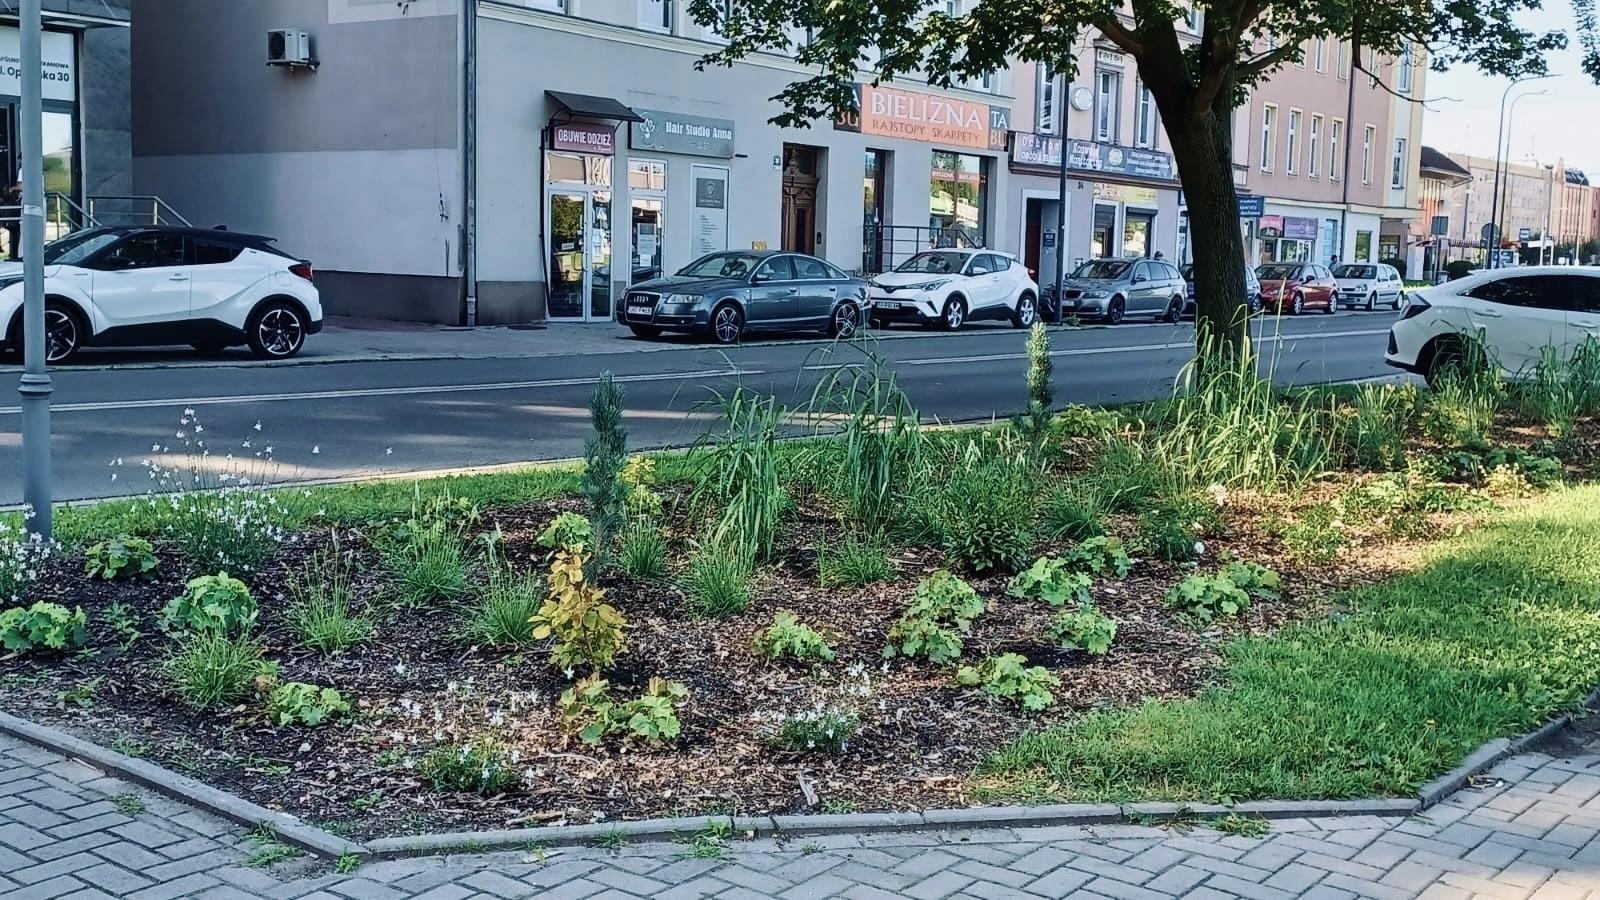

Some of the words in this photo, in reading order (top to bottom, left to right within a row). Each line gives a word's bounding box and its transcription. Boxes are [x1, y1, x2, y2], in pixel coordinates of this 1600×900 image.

[57, 72, 70, 82] 30
[871, 91, 983, 130] BIELIZNA
[991, 110, 1008, 129] TA
[558, 128, 586, 144] OBUWIE
[587, 132, 611, 146] ODZIEŻ
[665, 121, 684, 135] Hair
[685, 123, 711, 138] Studio
[712, 127, 732, 140] Anna
[872, 118, 926, 136] RAJSTOPY
[931, 126, 980, 143] SKARPETY
